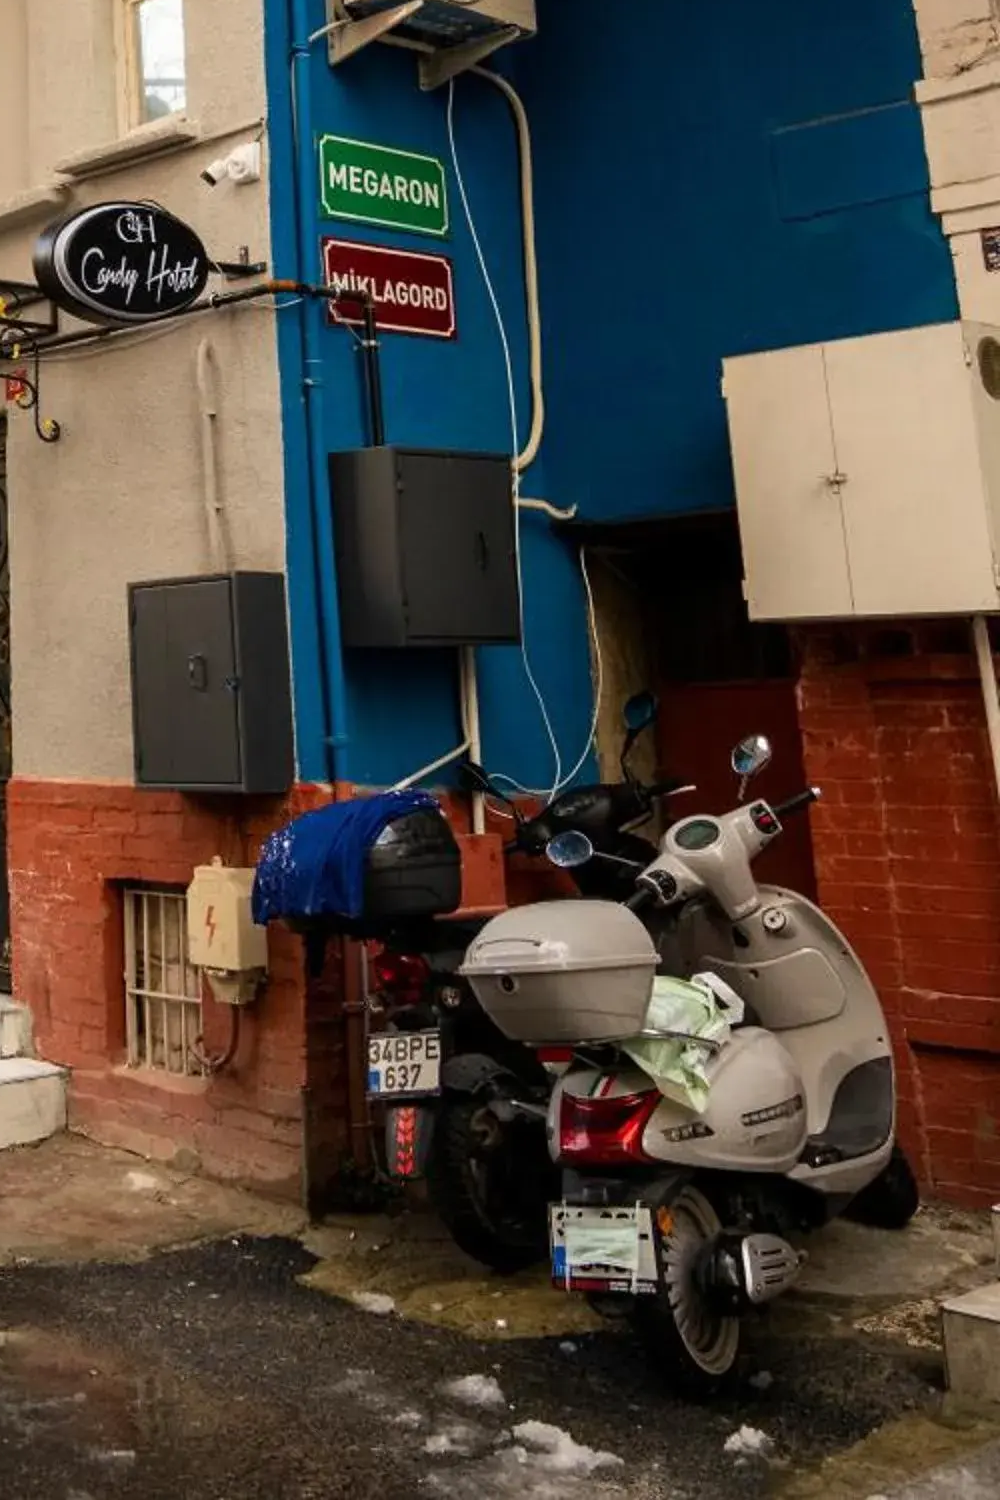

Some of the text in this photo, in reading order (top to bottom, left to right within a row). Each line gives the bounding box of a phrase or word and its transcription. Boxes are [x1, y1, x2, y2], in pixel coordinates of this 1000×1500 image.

[328, 161, 440, 209] MEGARON
[81, 244, 199, 305] Candy Hotel
[385, 1063, 422, 1089] 637
